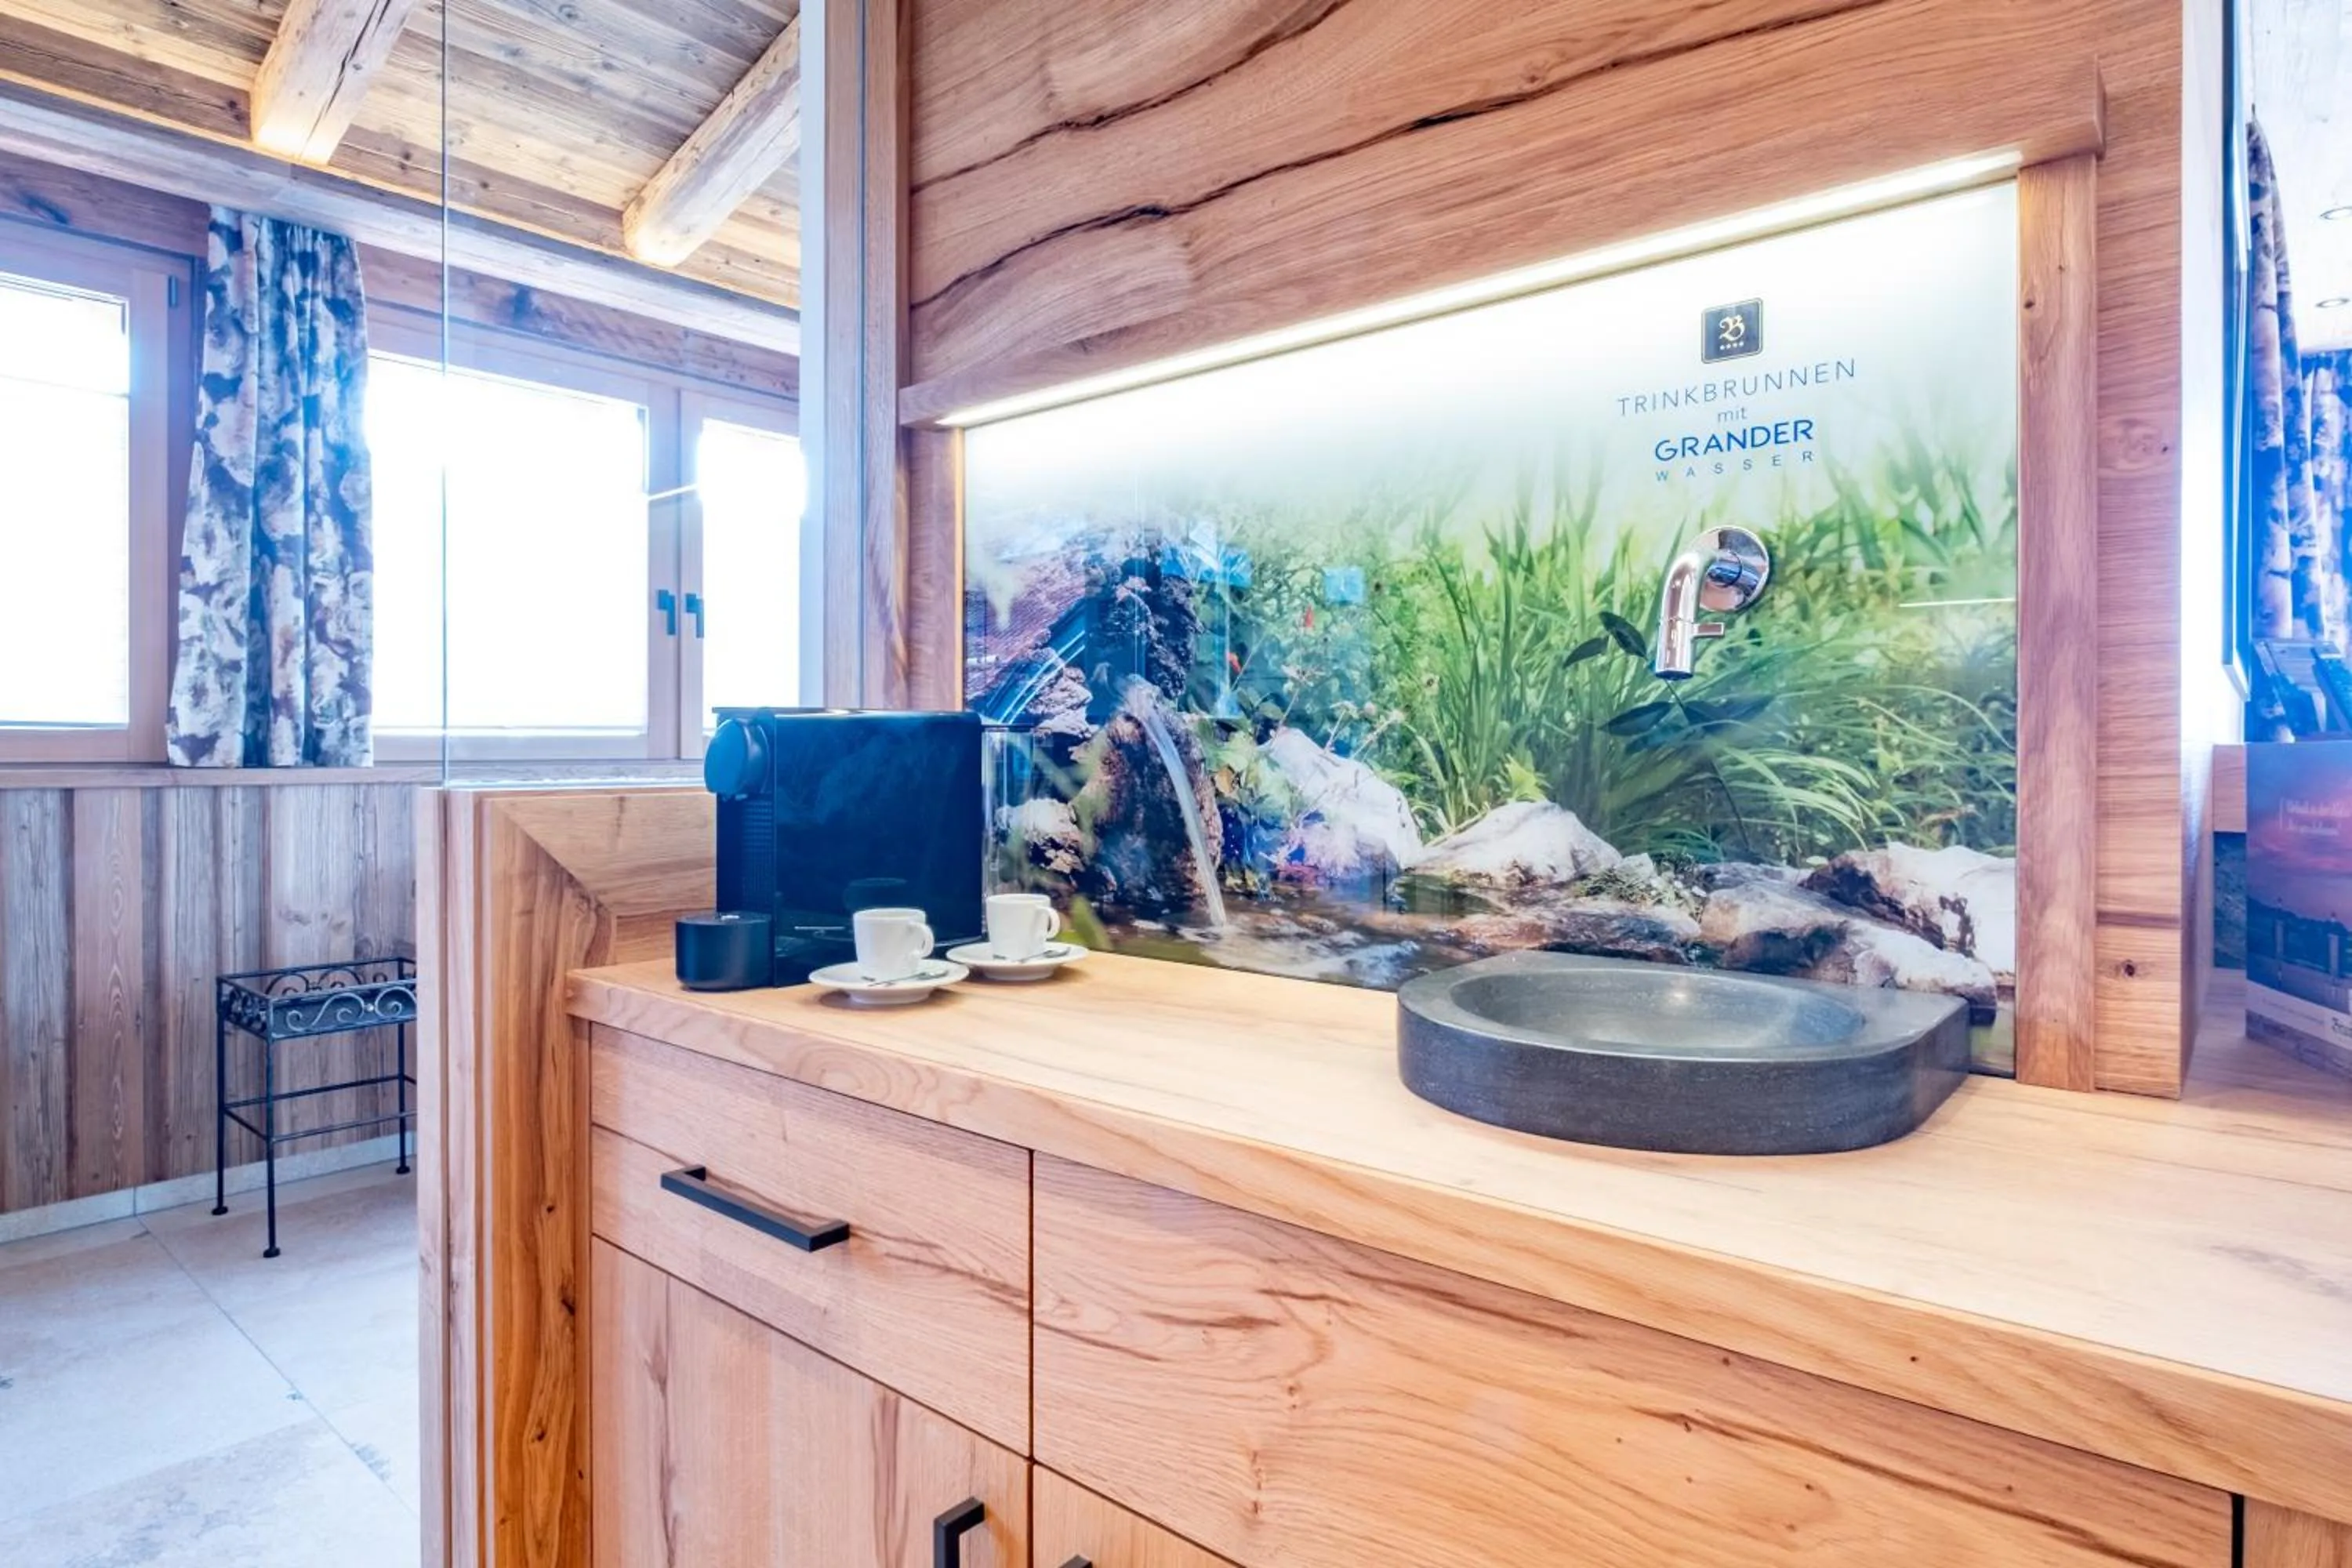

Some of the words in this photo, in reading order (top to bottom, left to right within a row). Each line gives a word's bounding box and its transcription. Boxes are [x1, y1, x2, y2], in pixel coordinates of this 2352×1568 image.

[1617, 358, 1856, 416] TRINKBRUNNEN
[1717, 407, 1748, 423] mit
[1654, 419, 1814, 462] GRANDER
[1655, 451, 1814, 482] WASSER
